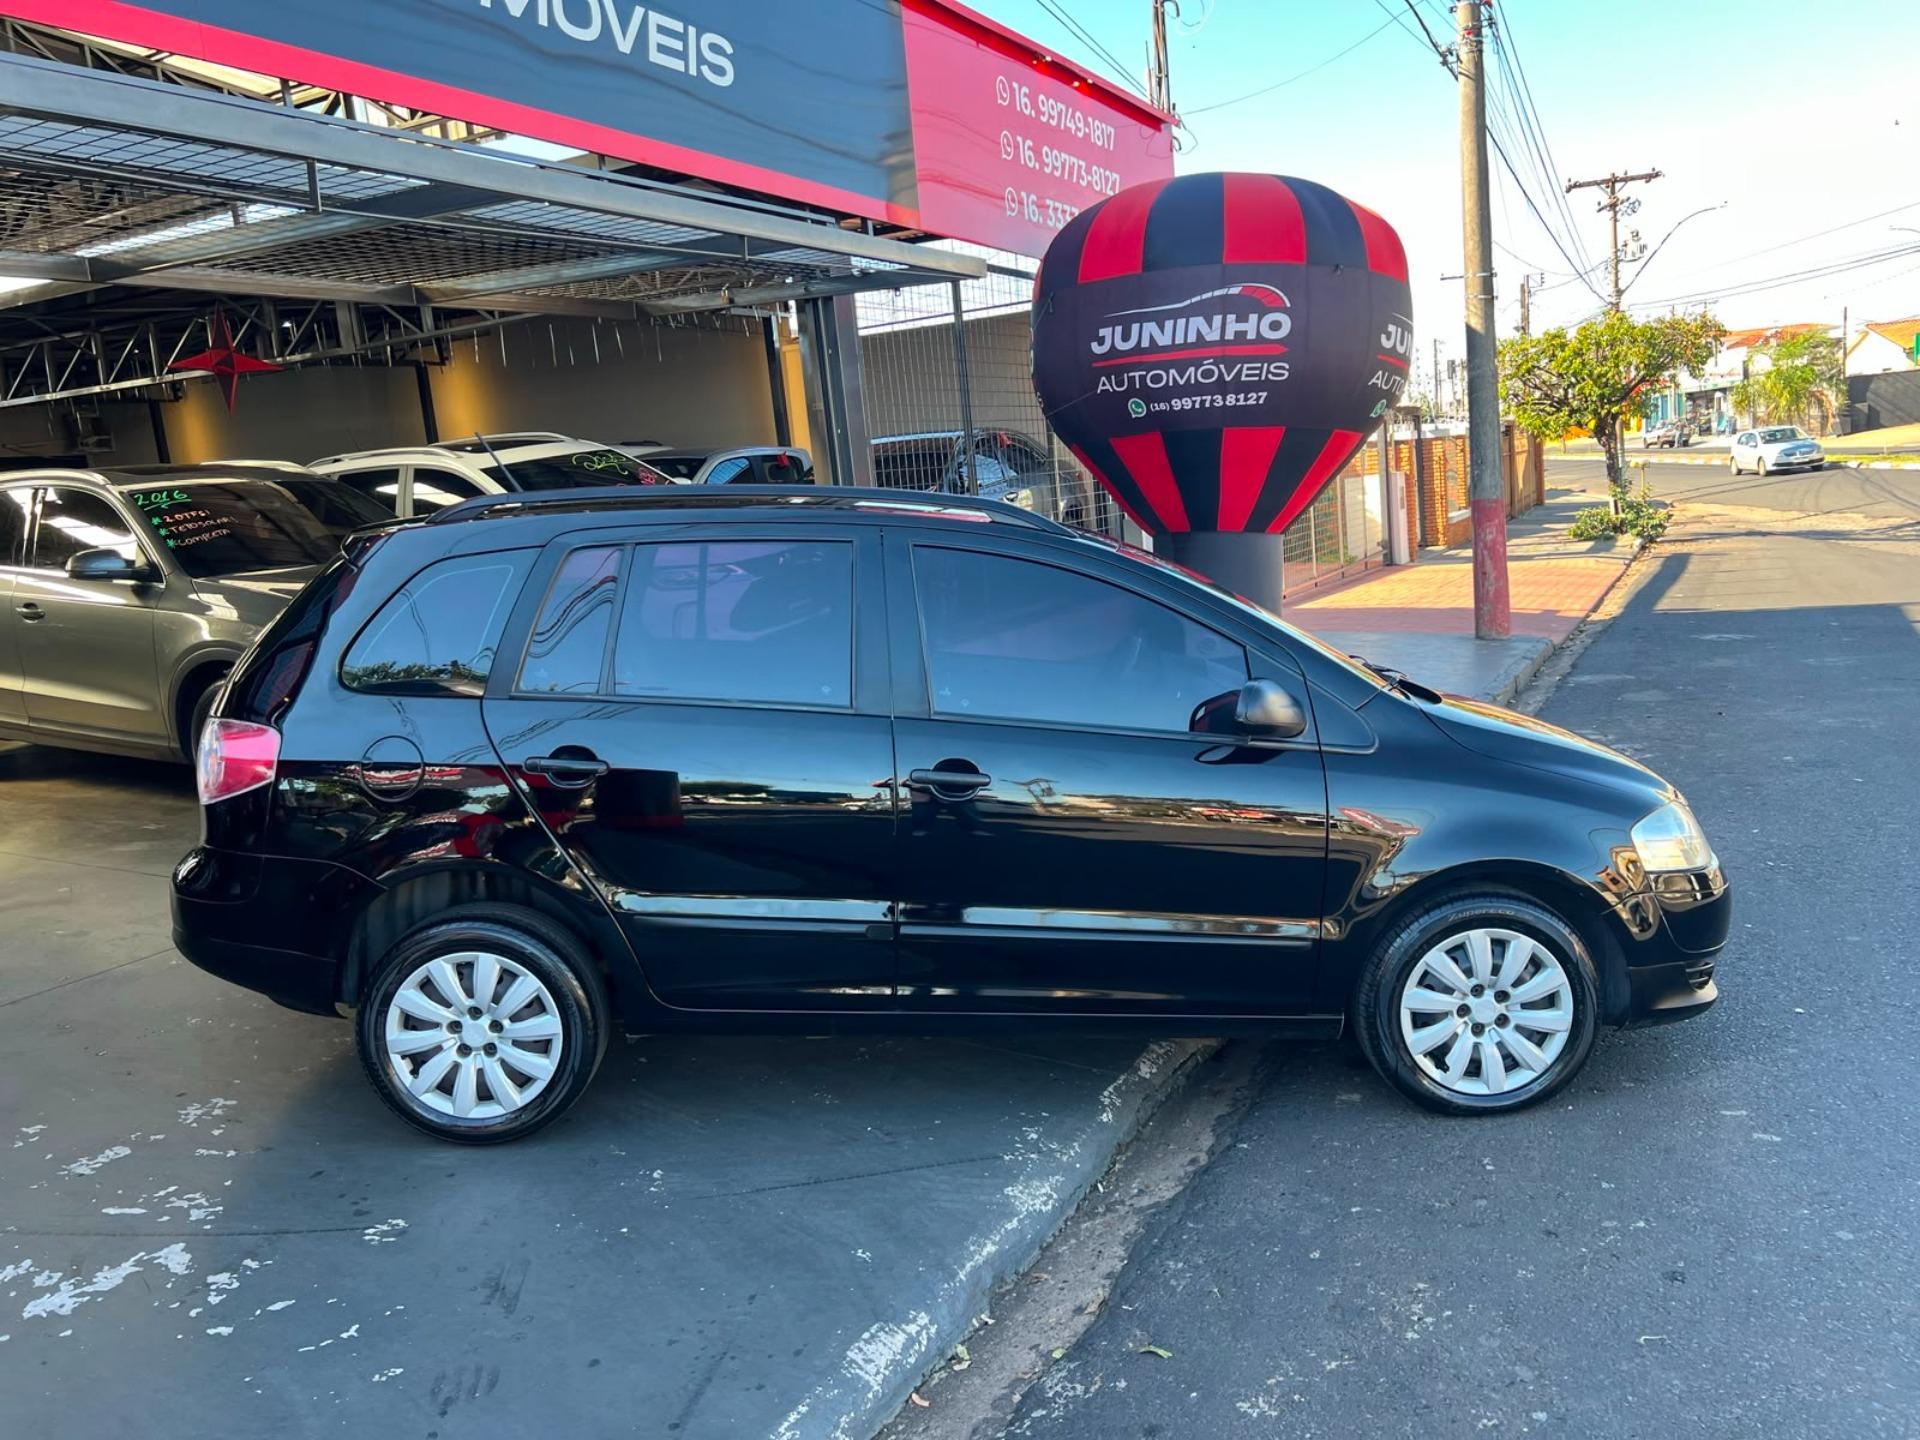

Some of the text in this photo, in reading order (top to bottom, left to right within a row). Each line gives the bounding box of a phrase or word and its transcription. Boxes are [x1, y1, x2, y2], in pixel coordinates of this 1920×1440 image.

[1012, 81, 1115, 151] 16. 99749-1817
[1016, 135, 1120, 196] 16. 99773-8127
[1021, 191, 1043, 224] 16.
[1090, 312, 1292, 355] JUNINHO
[1097, 359, 1290, 394] AUTOMÓVEIS
[1150, 401, 1170, 412] (16)
